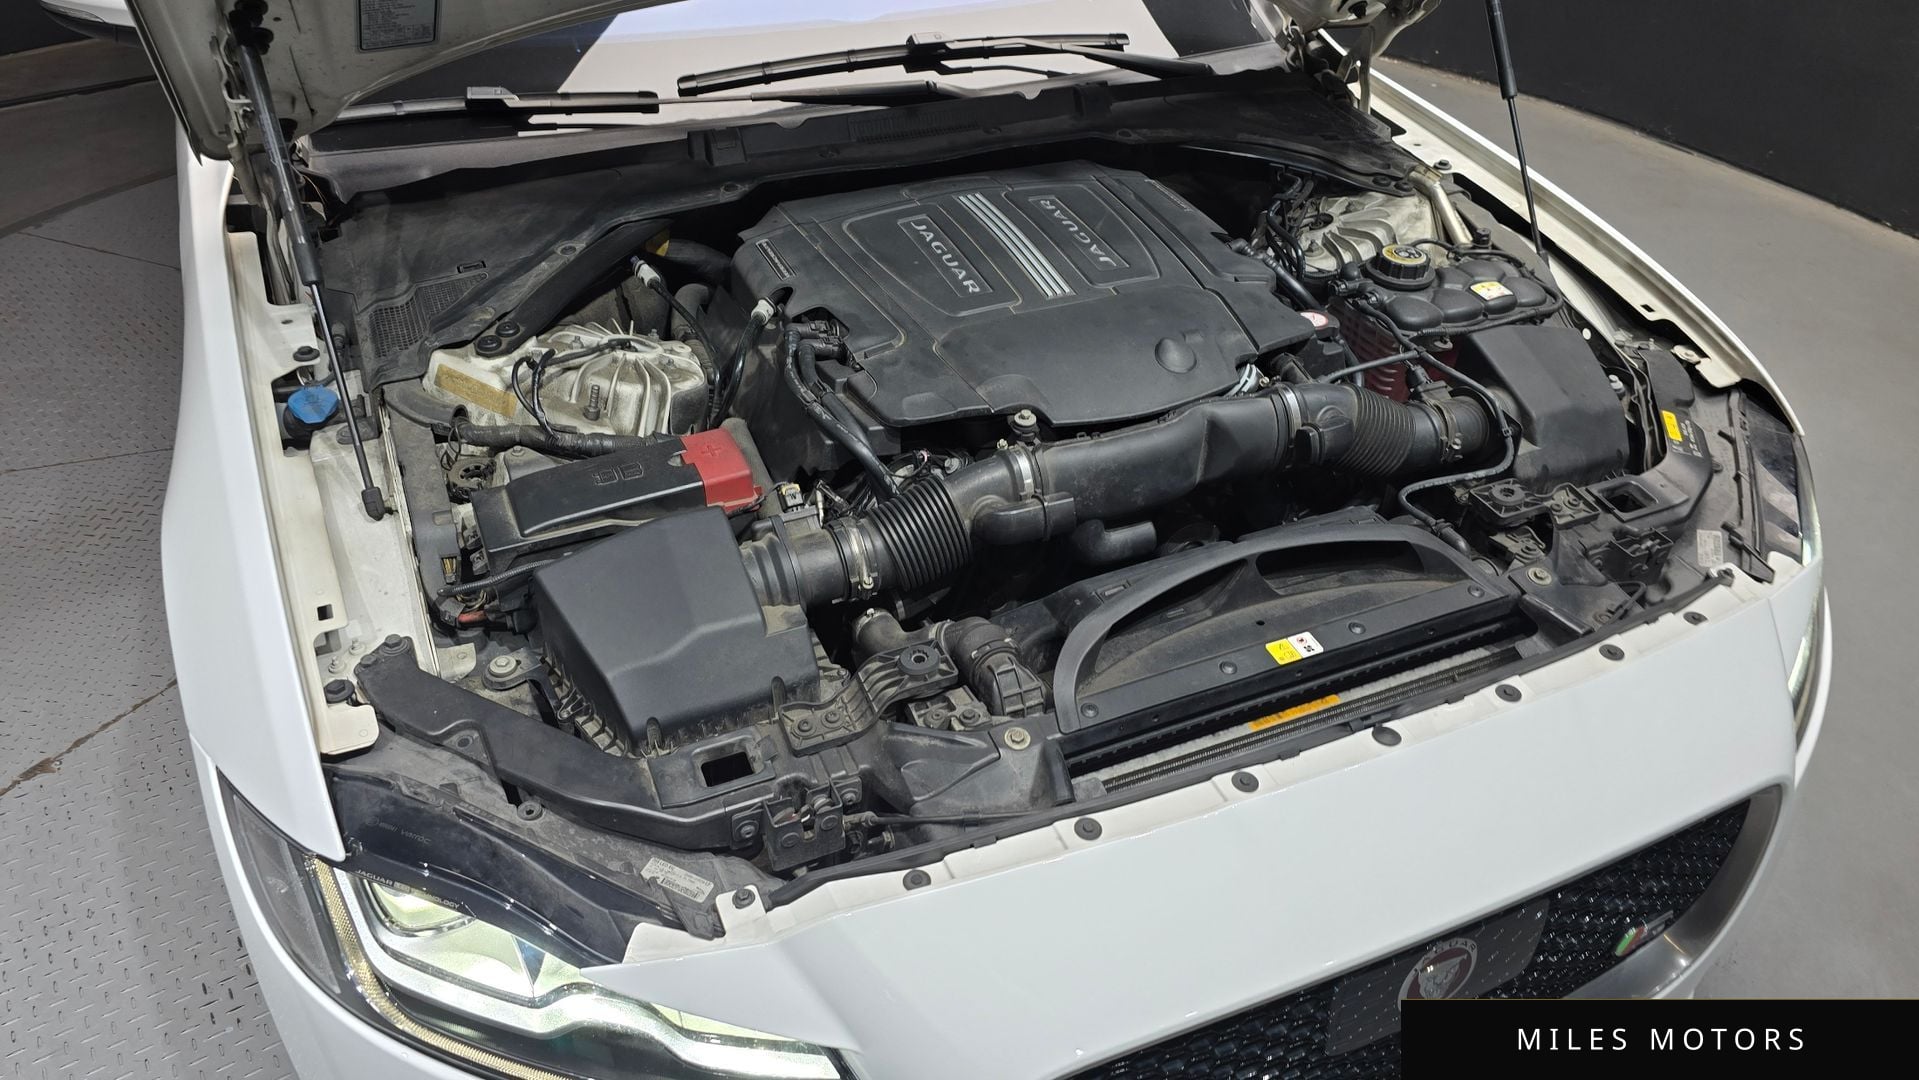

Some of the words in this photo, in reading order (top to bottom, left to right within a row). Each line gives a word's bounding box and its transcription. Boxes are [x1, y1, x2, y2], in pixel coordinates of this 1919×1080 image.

[910, 221, 981, 293] JAGUAR
[1040, 200, 1117, 267] JAGUAR
[356, 869, 393, 887] JAGUAR
